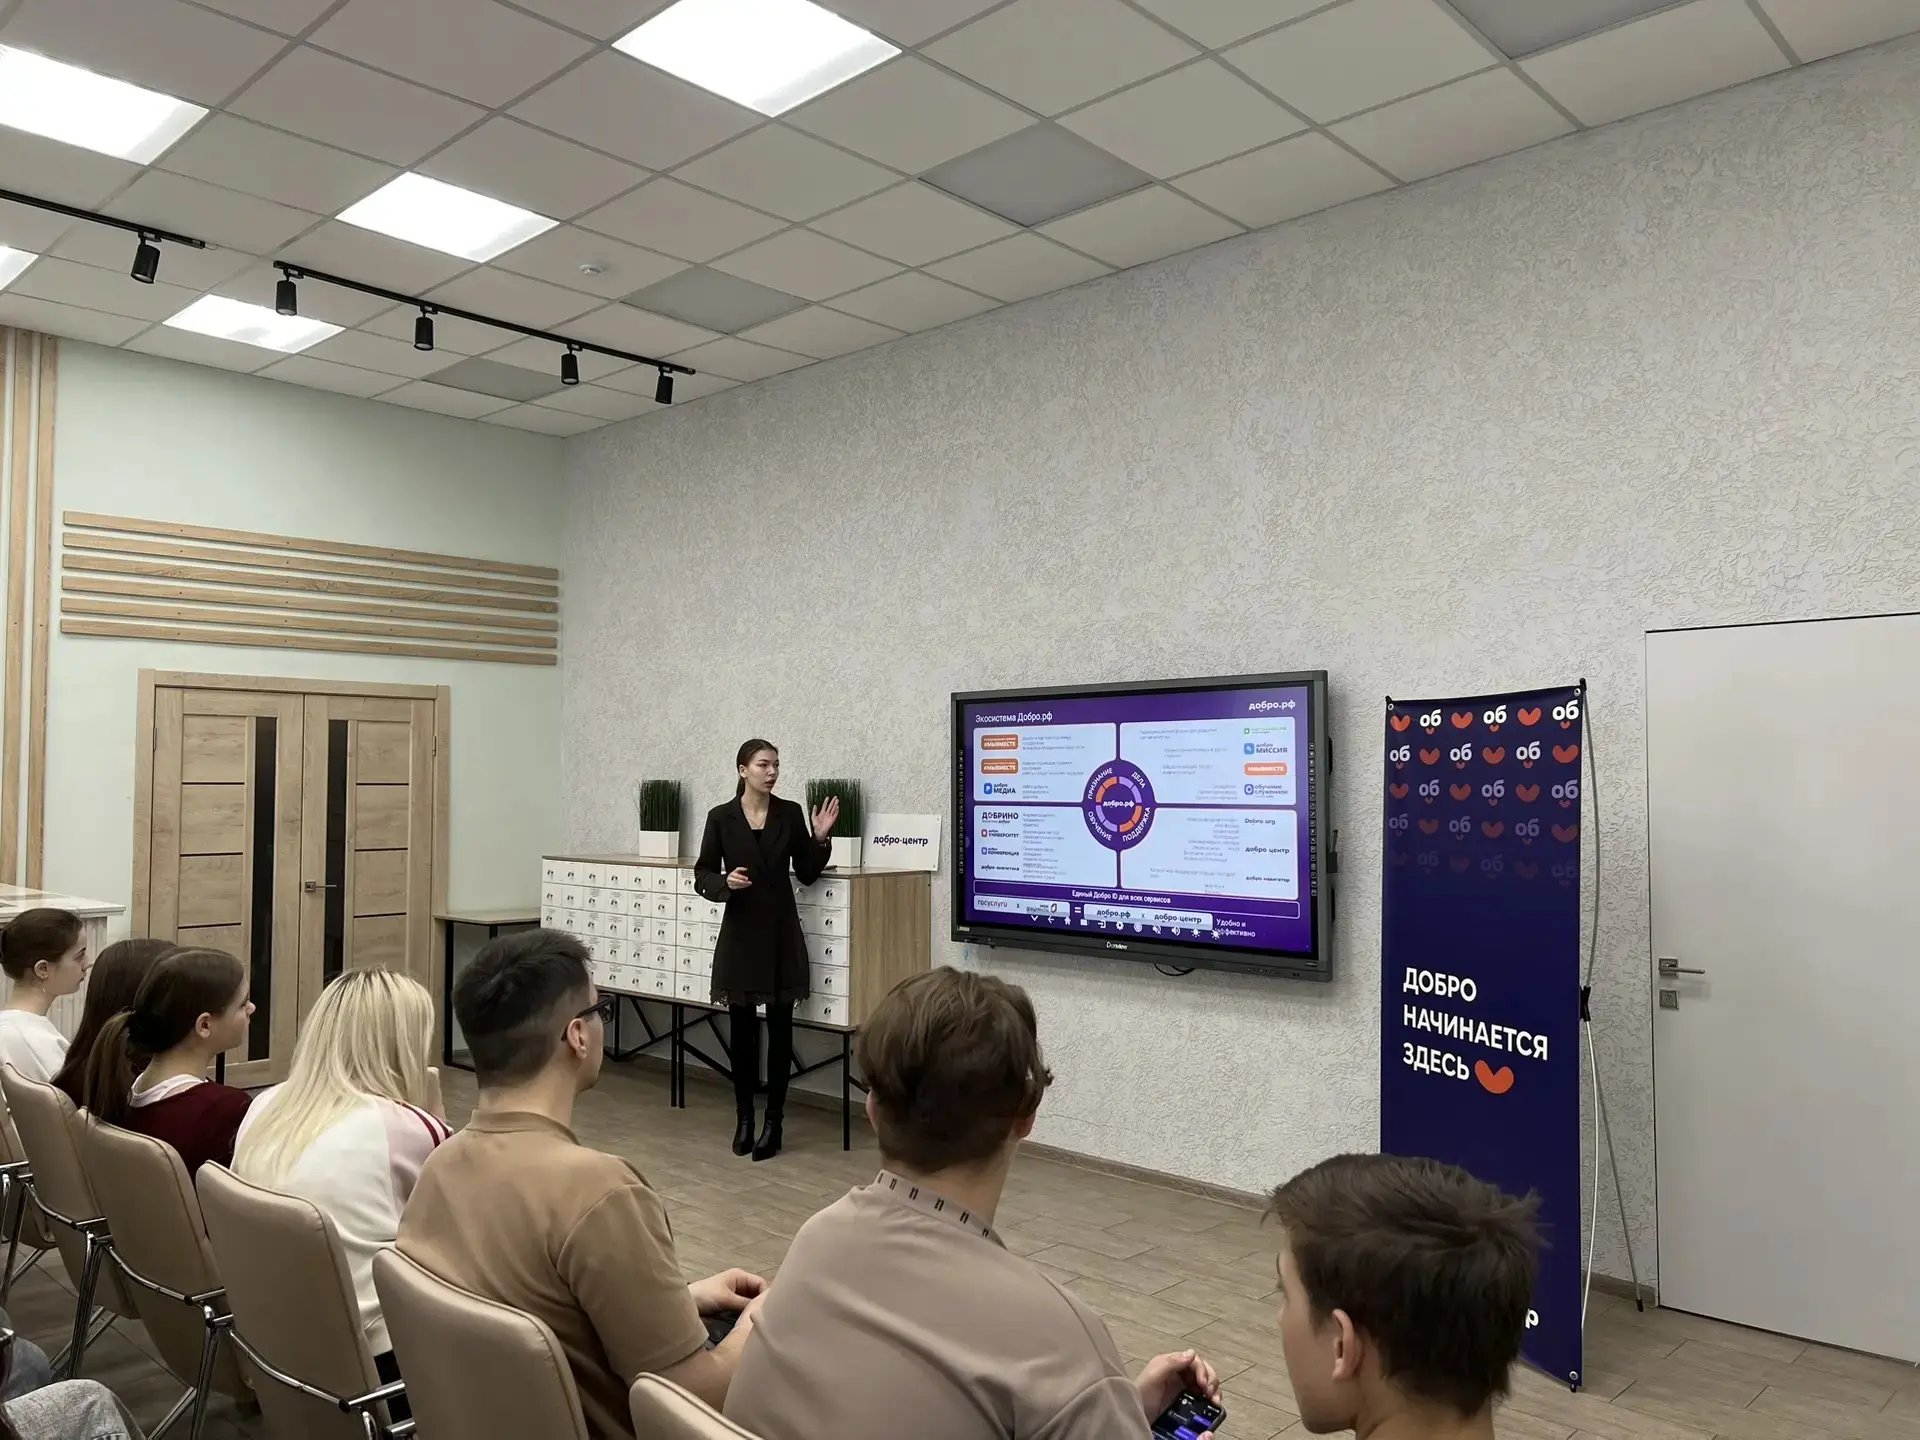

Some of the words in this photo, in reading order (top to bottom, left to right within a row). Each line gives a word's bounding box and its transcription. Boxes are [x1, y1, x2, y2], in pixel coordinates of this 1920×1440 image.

[1248, 700, 1296, 711] добро.рф
[976, 714, 1016, 723] Экосистема
[1017, 711, 1052, 723] Добро.рф
[1088, 768, 1112, 800] ПРИЗНАНИЕ
[1132, 772, 1146, 788] ДЕЛА
[1103, 800, 1134, 808] добро.рф
[982, 812, 1018, 820] ДОБРИНО
[1088, 811, 1112, 841] ОБУЧЕНИЕ
[1122, 806, 1150, 842] ПОДДЕРЖКА
[1072, 890, 1092, 898] Единый
[1093, 892, 1112, 900] Добро
[1096, 908, 1130, 918] добро.рф
[1216, 918, 1240, 928] Удобно
[1402, 967, 1478, 1002] ДОБРО
[1403, 1004, 1548, 1060] НАЧИНАЕТСЯ
[1402, 1042, 1470, 1080] ЗДЕСЬ
